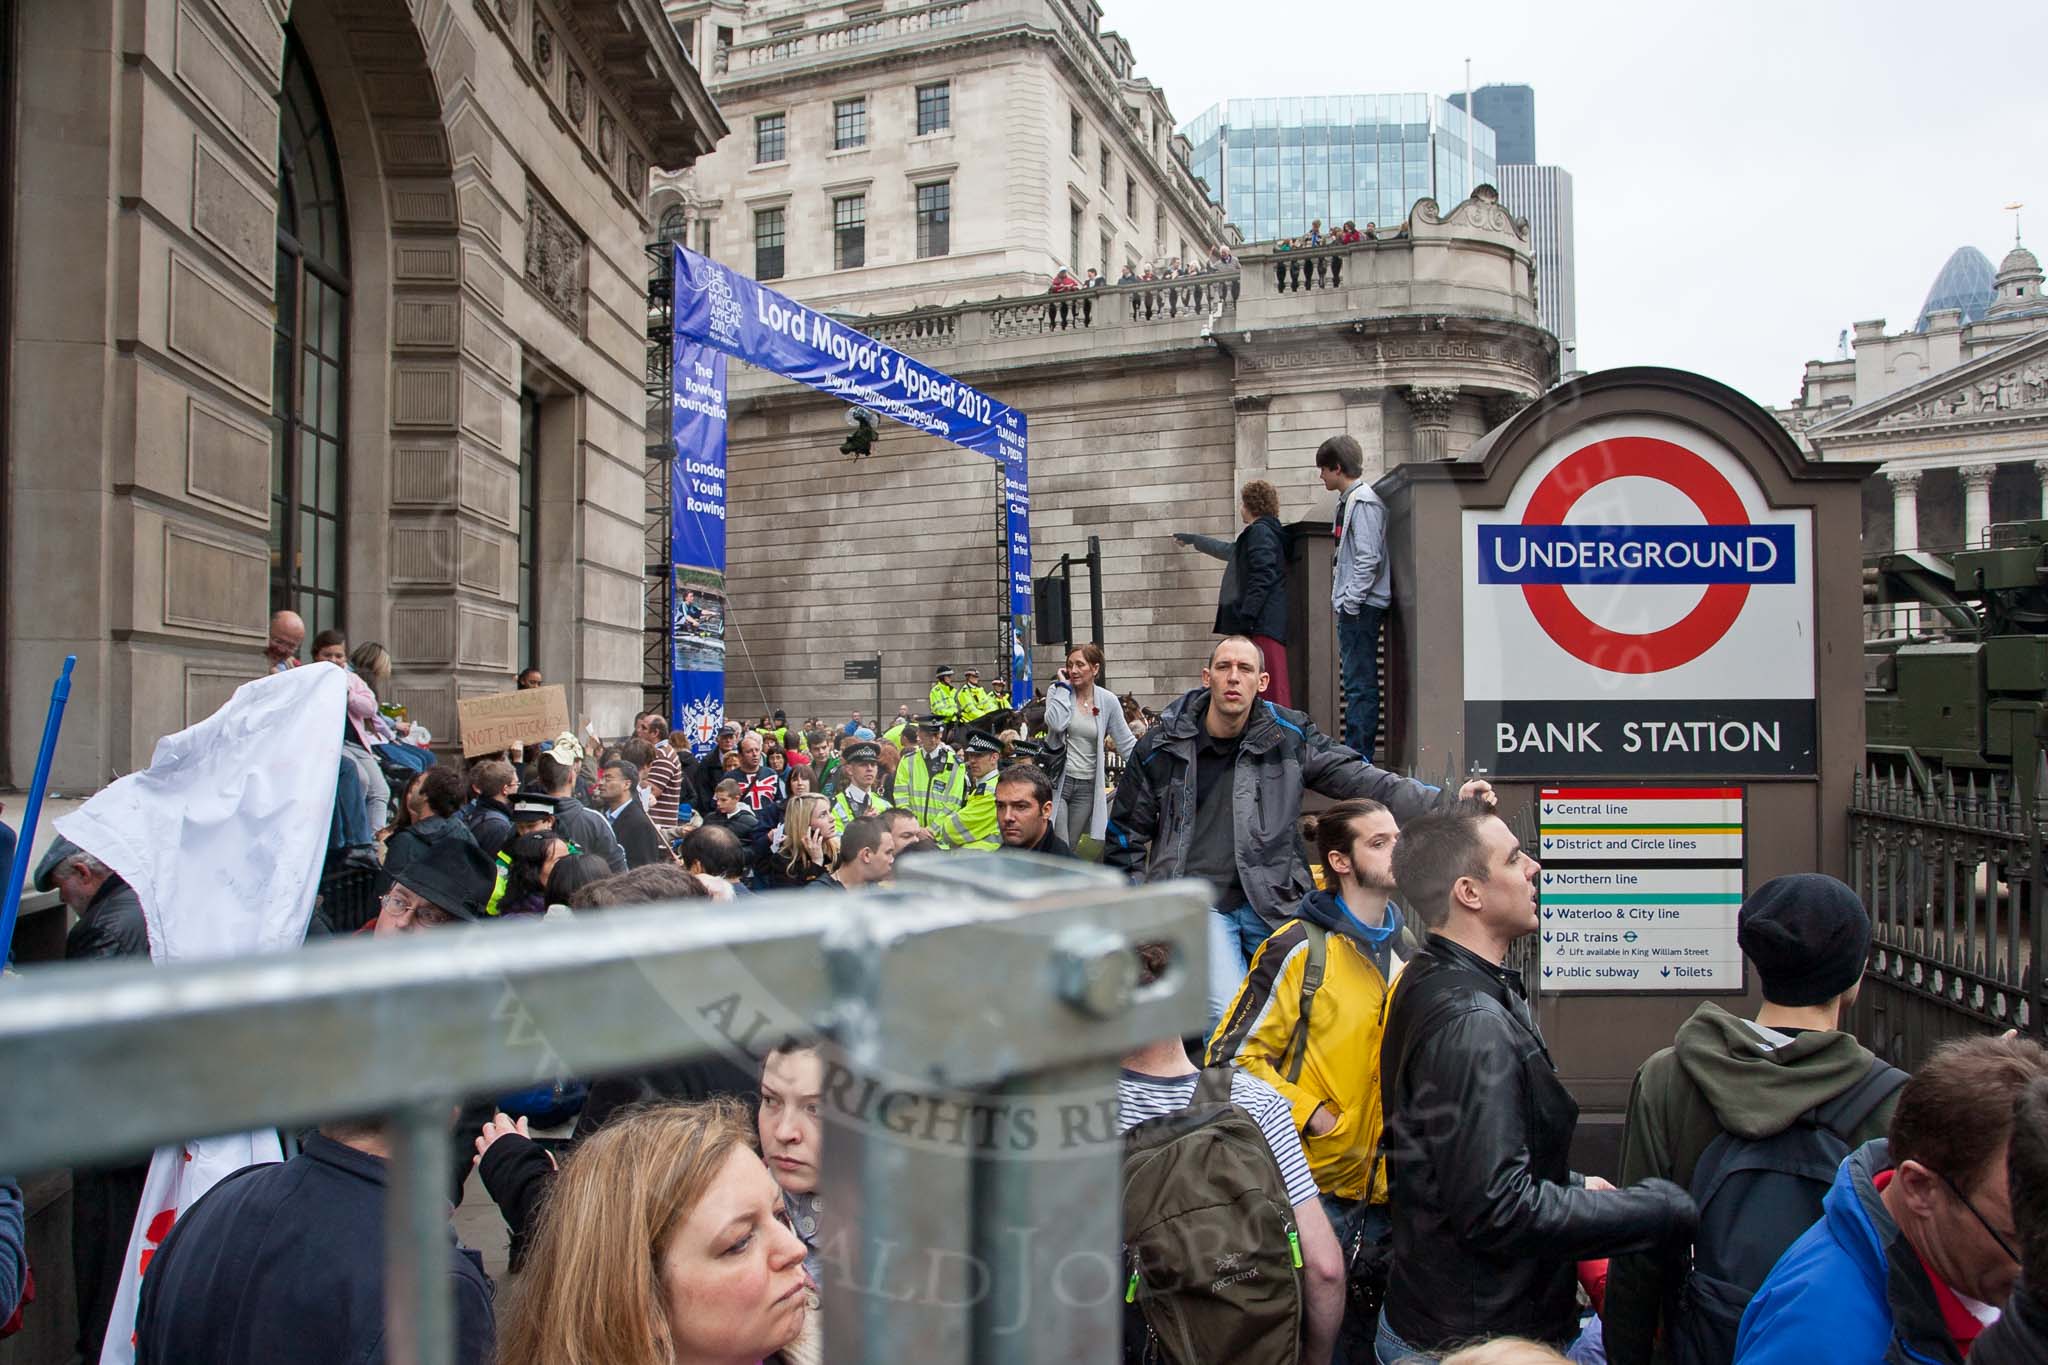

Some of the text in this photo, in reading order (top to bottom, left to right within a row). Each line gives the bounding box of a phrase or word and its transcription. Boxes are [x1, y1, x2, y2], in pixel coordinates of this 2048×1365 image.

[757, 288, 992, 426] Lord Mayor's Appeal 2012
[694, 362, 713, 379] The
[685, 377, 722, 403] Rowing
[686, 458, 726, 480] London
[691, 478, 723, 498] Youth
[687, 497, 726, 520] Rowing
[1496, 721, 1781, 753] BANK STATION
[1556, 804, 1628, 815] Central line
[1556, 838, 1697, 850] District and Circle lines
[1556, 874, 1638, 885] Northern line
[1557, 908, 1680, 922] Waterloo & City line
[1556, 932, 1618, 943] DLR trains
[1569, 948, 1709, 958] Lift available in King William Street
[1556, 966, 1640, 980] Public subway
[1674, 966, 1713, 978] Toilets
